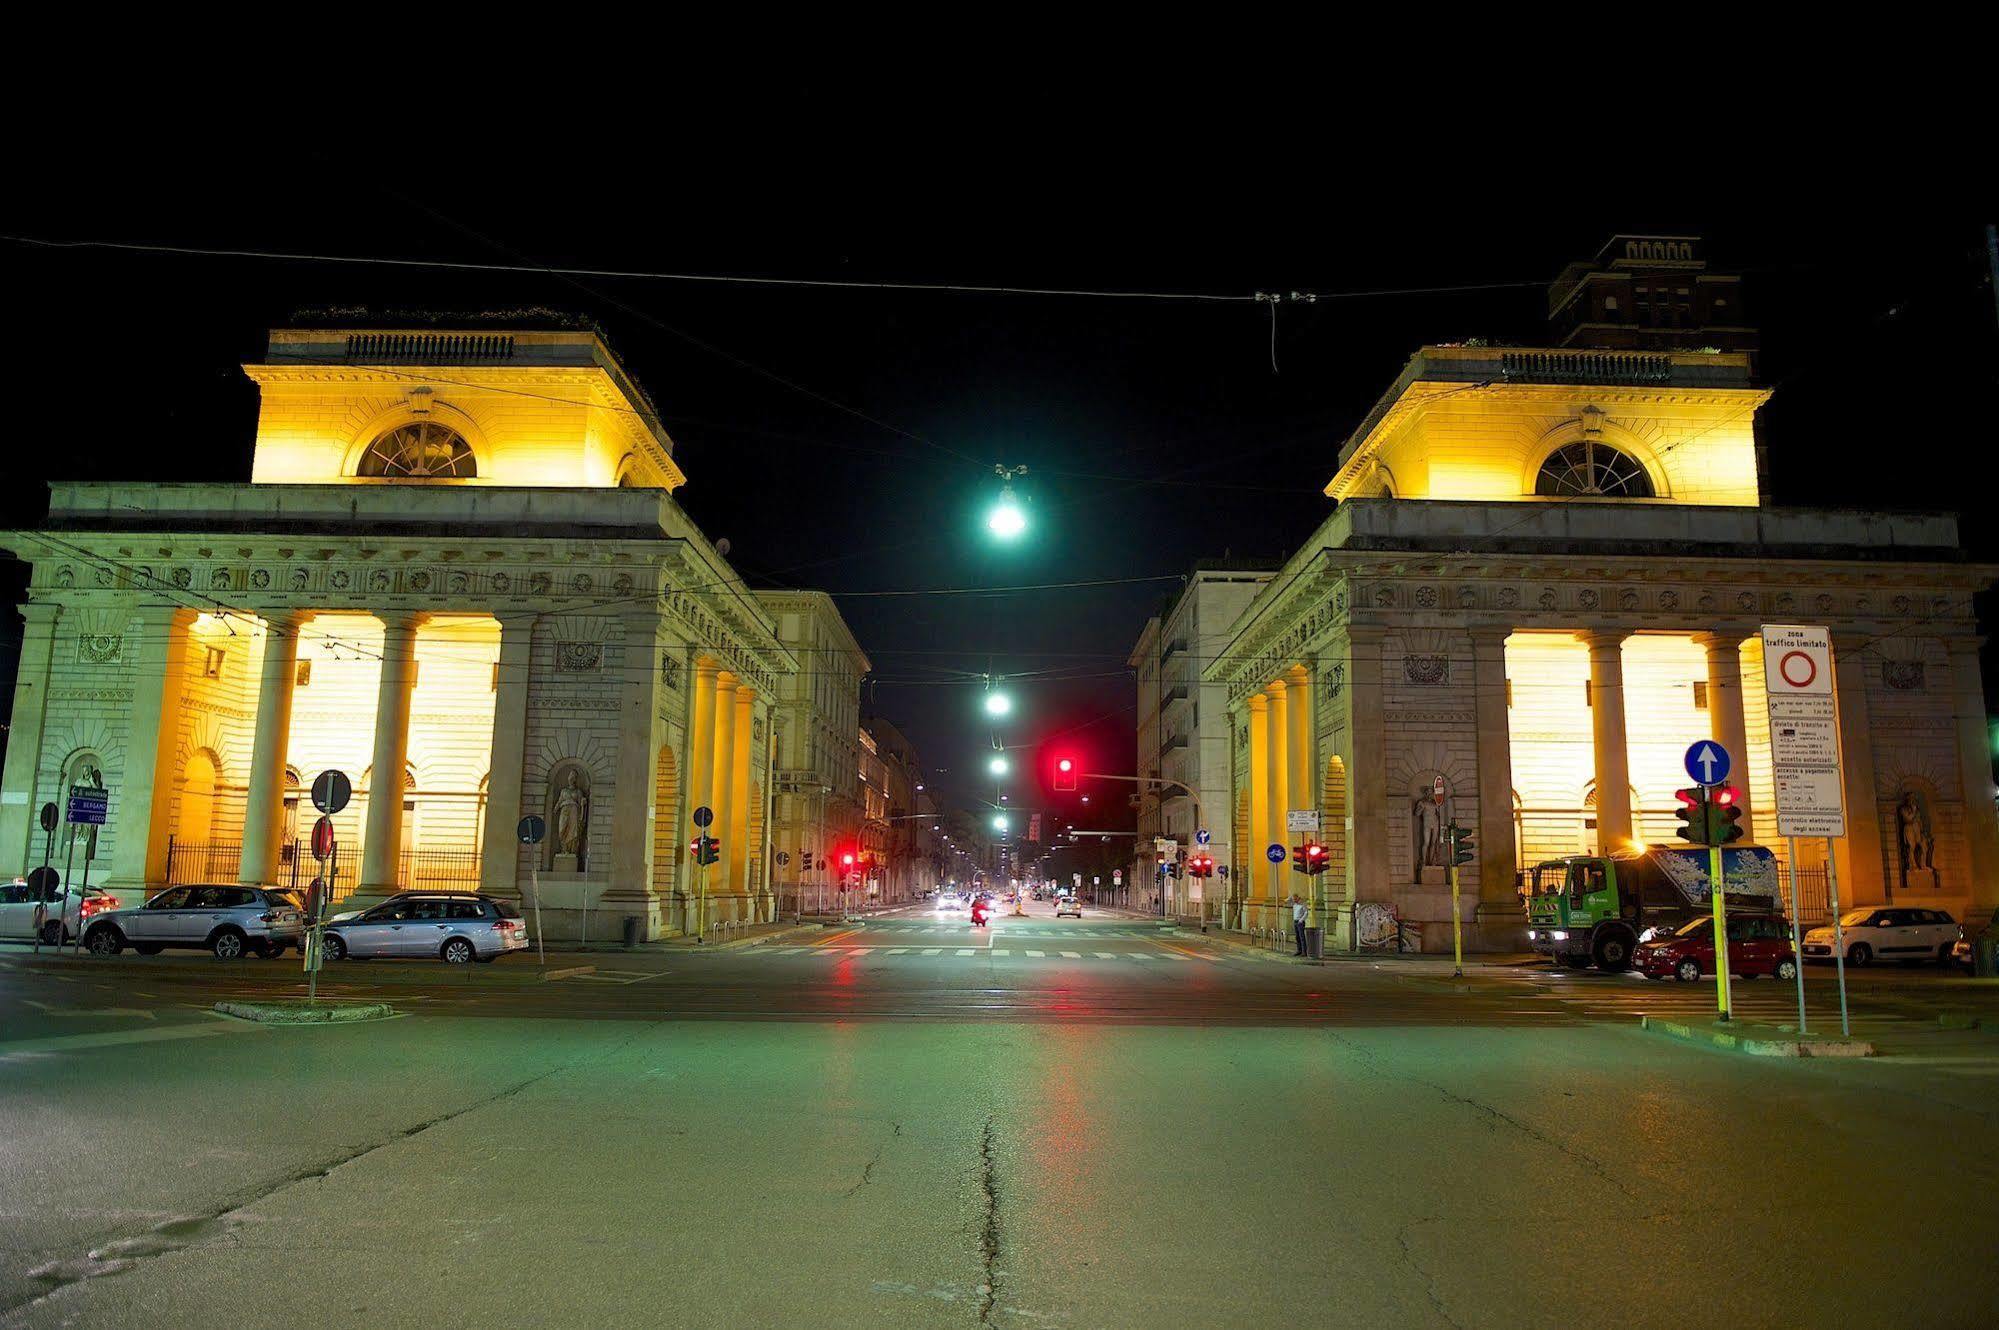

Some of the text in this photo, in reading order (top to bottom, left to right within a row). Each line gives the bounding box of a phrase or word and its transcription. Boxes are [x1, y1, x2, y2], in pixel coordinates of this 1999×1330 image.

[1766, 639, 1827, 648] traffico limitato
[83, 802, 106, 810] BERGAMO
[89, 814, 105, 822] LECCO
